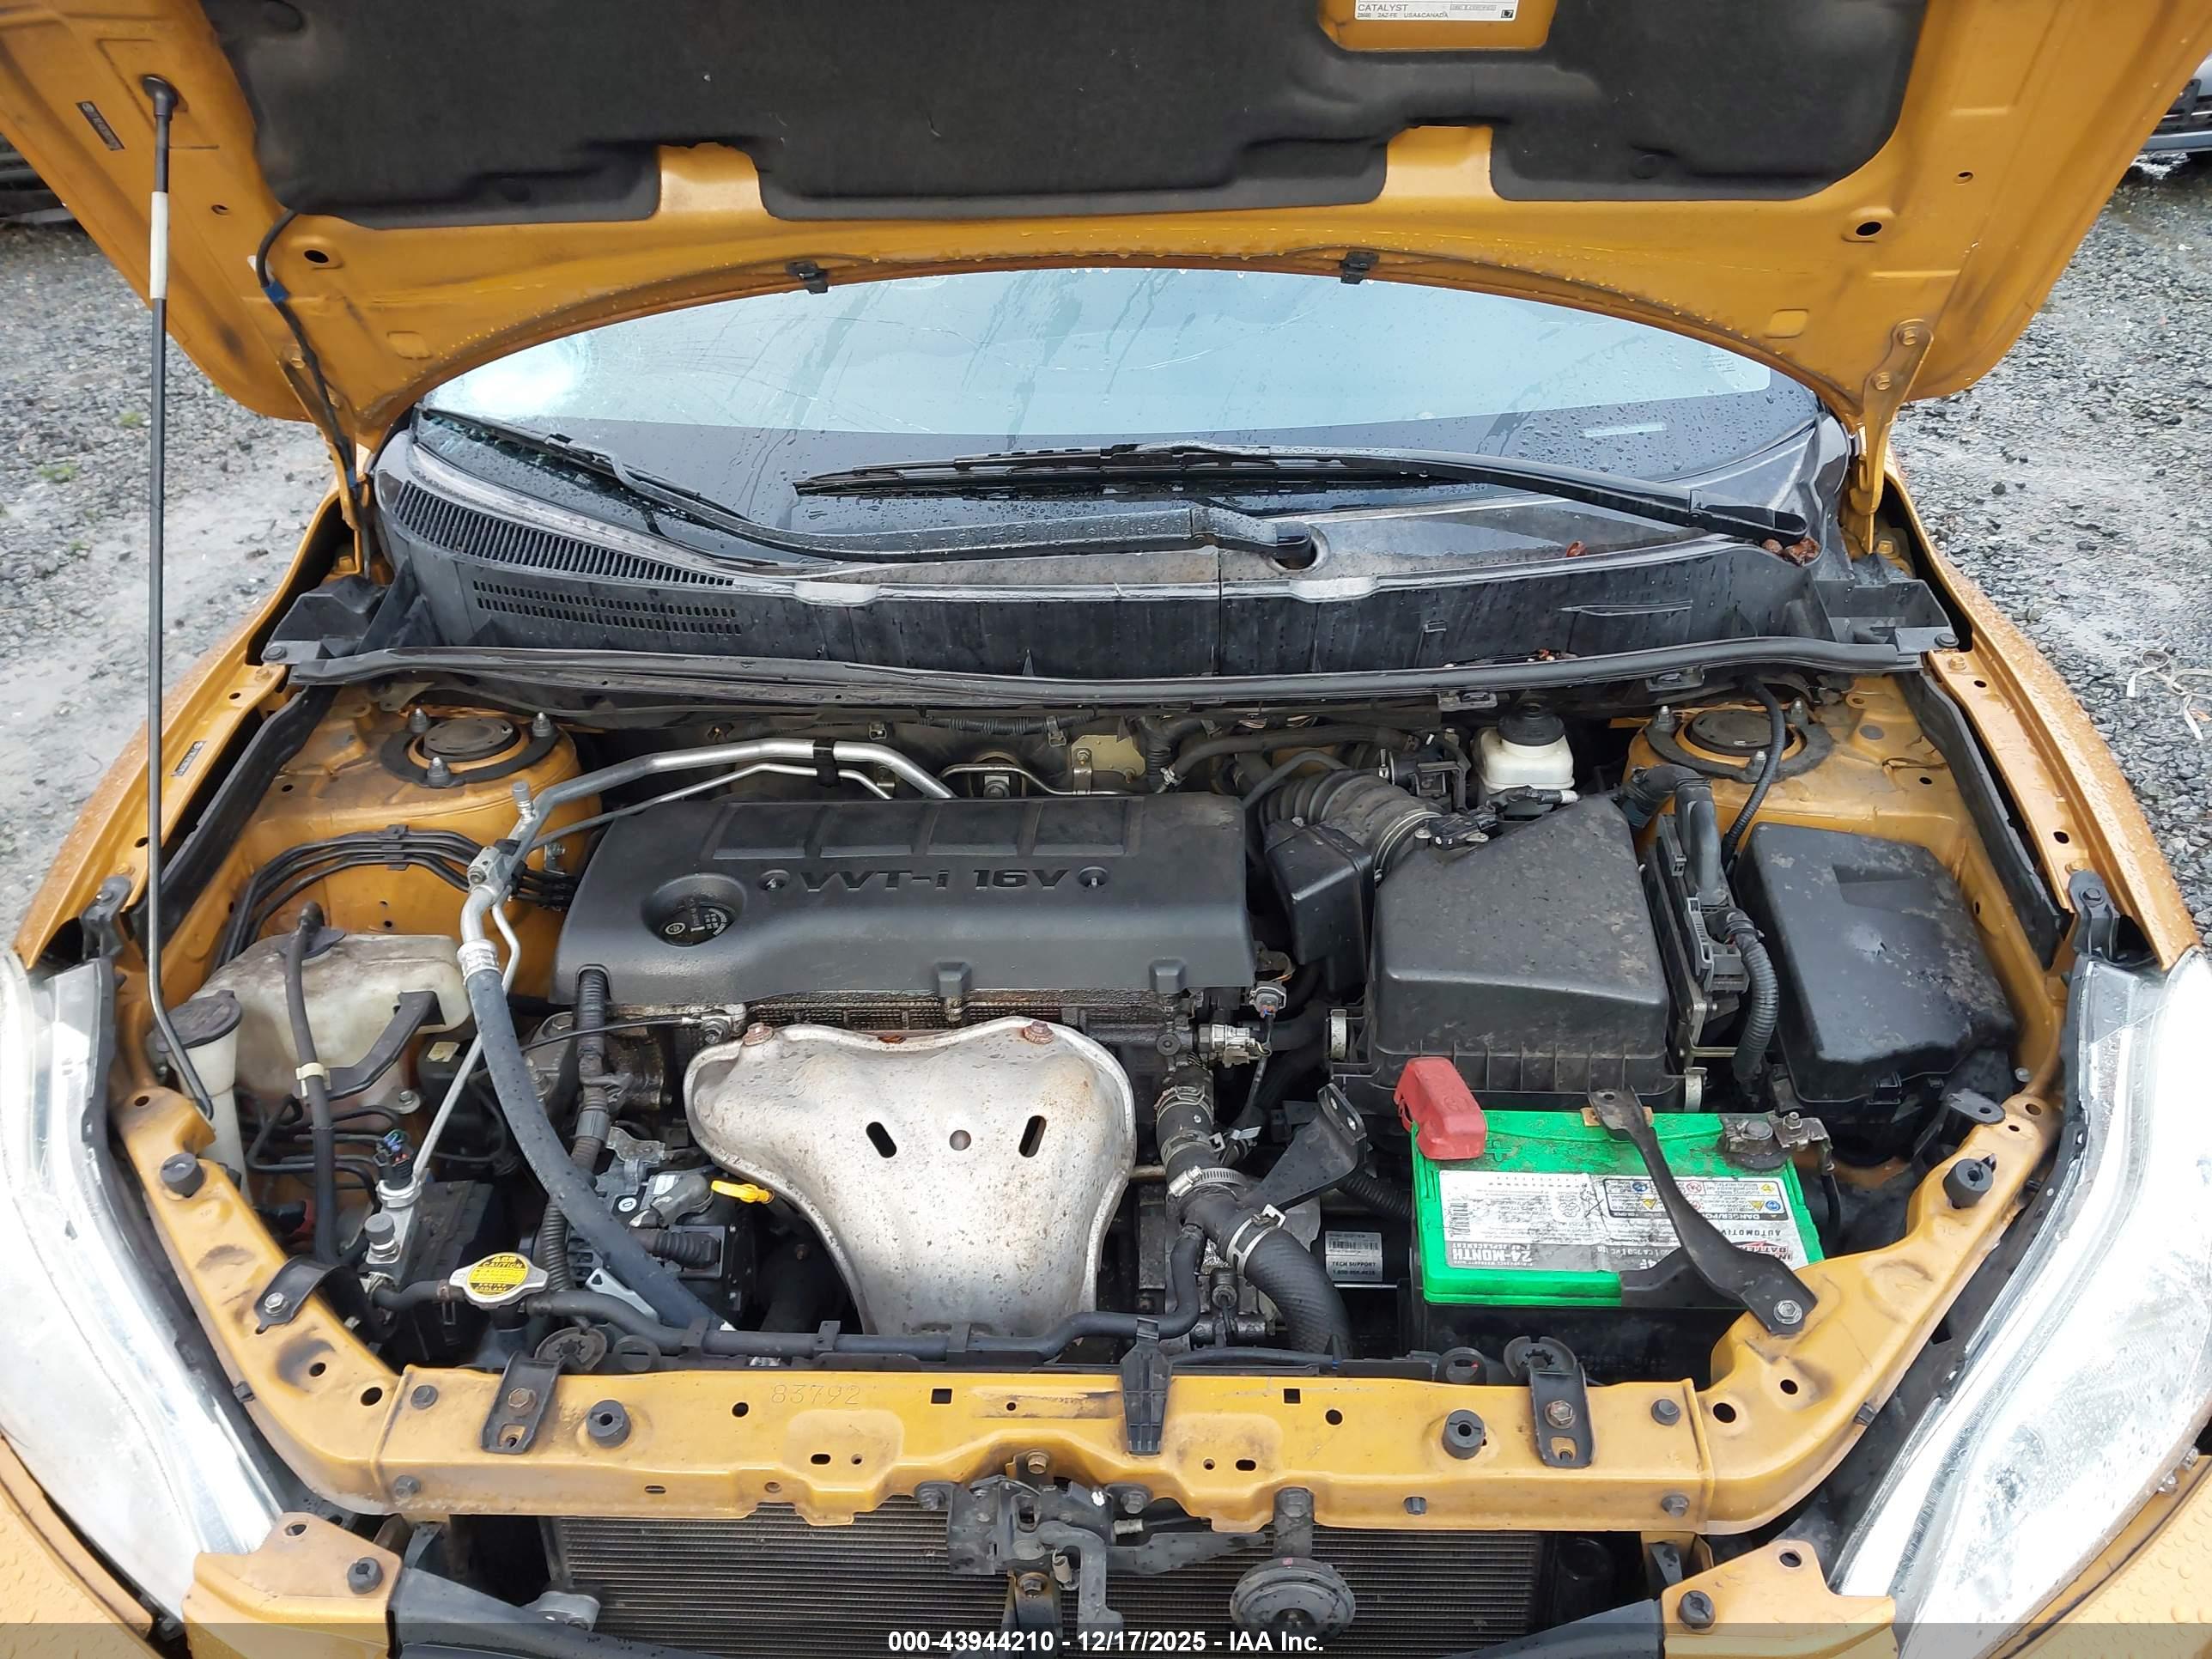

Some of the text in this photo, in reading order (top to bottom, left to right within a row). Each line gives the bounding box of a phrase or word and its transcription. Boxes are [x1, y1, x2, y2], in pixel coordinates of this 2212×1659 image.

[972, 868, 1071, 891] 16V
[1452, 1248, 1533, 1262] 24-MONTH
[770, 1384, 860, 1404] 83792
